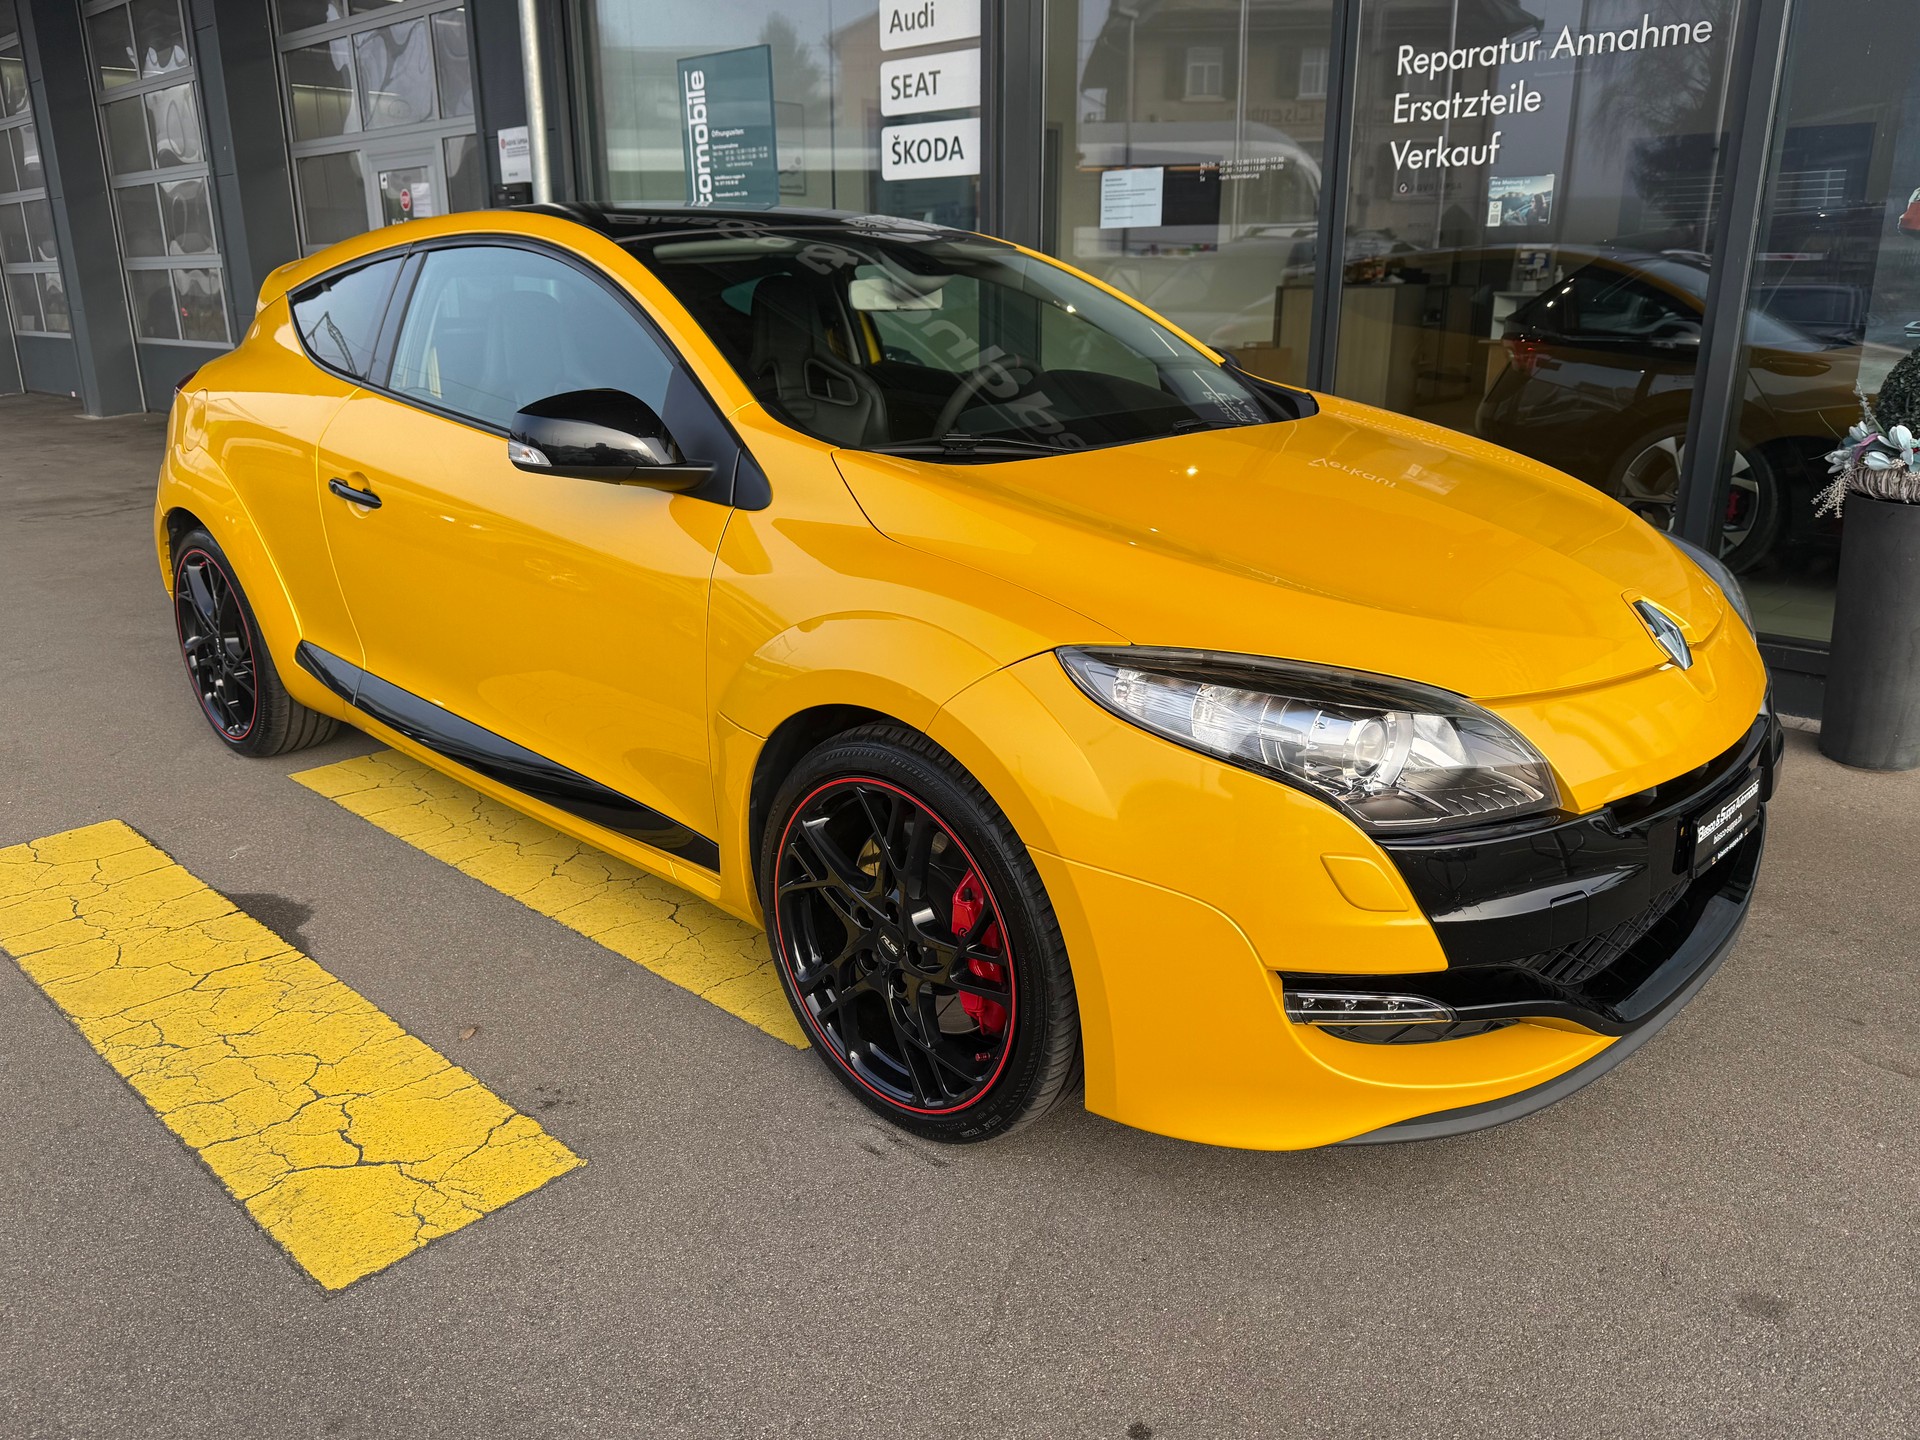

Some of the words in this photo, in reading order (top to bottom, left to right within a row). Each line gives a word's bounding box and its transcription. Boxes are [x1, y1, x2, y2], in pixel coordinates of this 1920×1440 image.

[889, 1, 935, 34] Audi
[1396, 38, 1542, 80] Reparatur
[1550, 13, 1713, 60] Annahme
[890, 69, 941, 101] SEAT
[1393, 79, 1542, 124] Ersatzteile
[891, 134, 964, 166] ŠKODA
[1390, 131, 1502, 170] Verkauf
